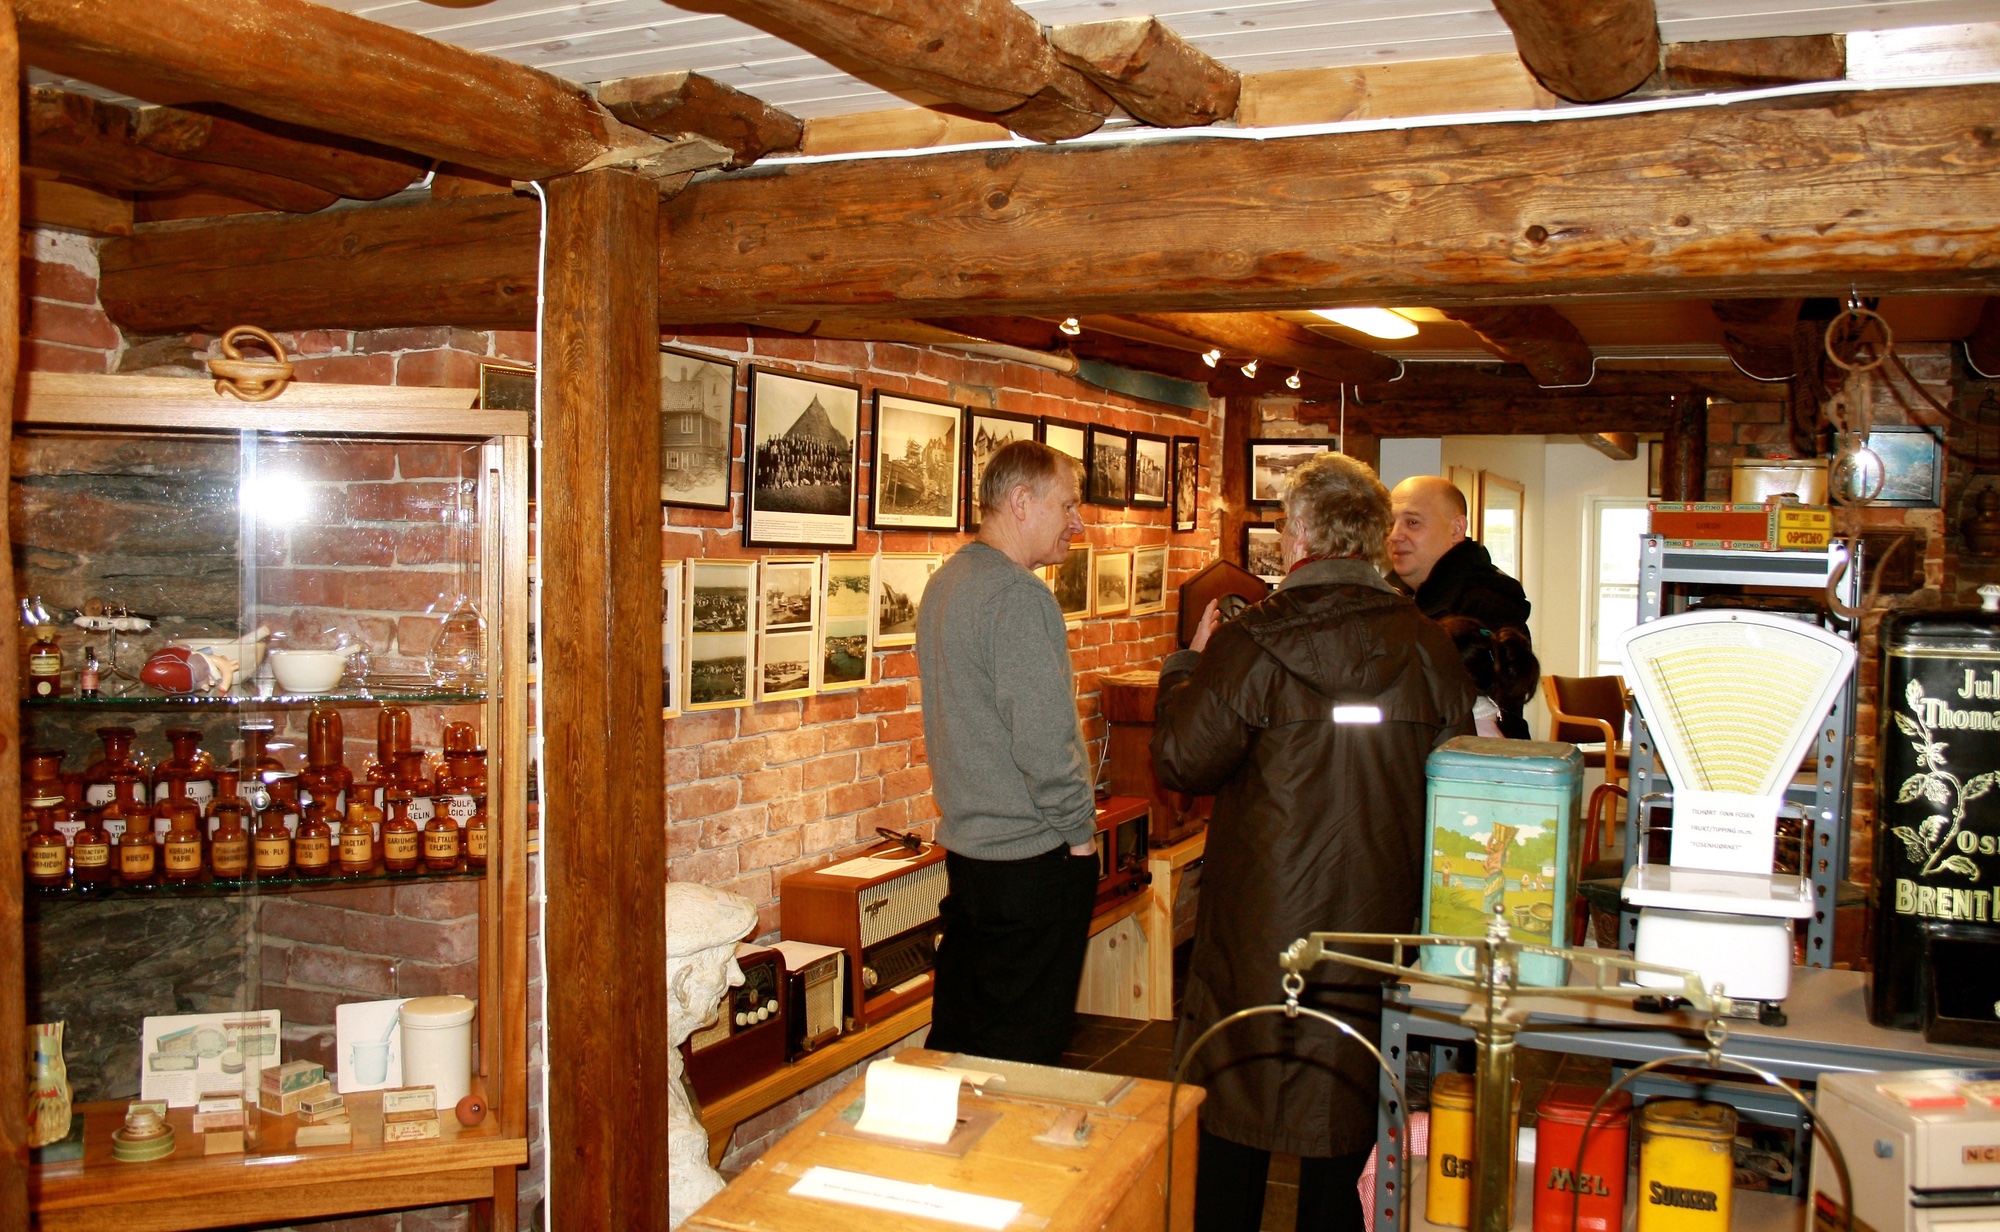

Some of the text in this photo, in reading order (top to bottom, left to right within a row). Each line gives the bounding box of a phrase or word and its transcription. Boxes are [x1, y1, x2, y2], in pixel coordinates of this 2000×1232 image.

[1786, 531, 1823, 545] OPTIMO
[1735, 811, 1755, 819] FOSEN
[1546, 1166, 1610, 1197] MEL
[1649, 1179, 1718, 1212] SUKKER
